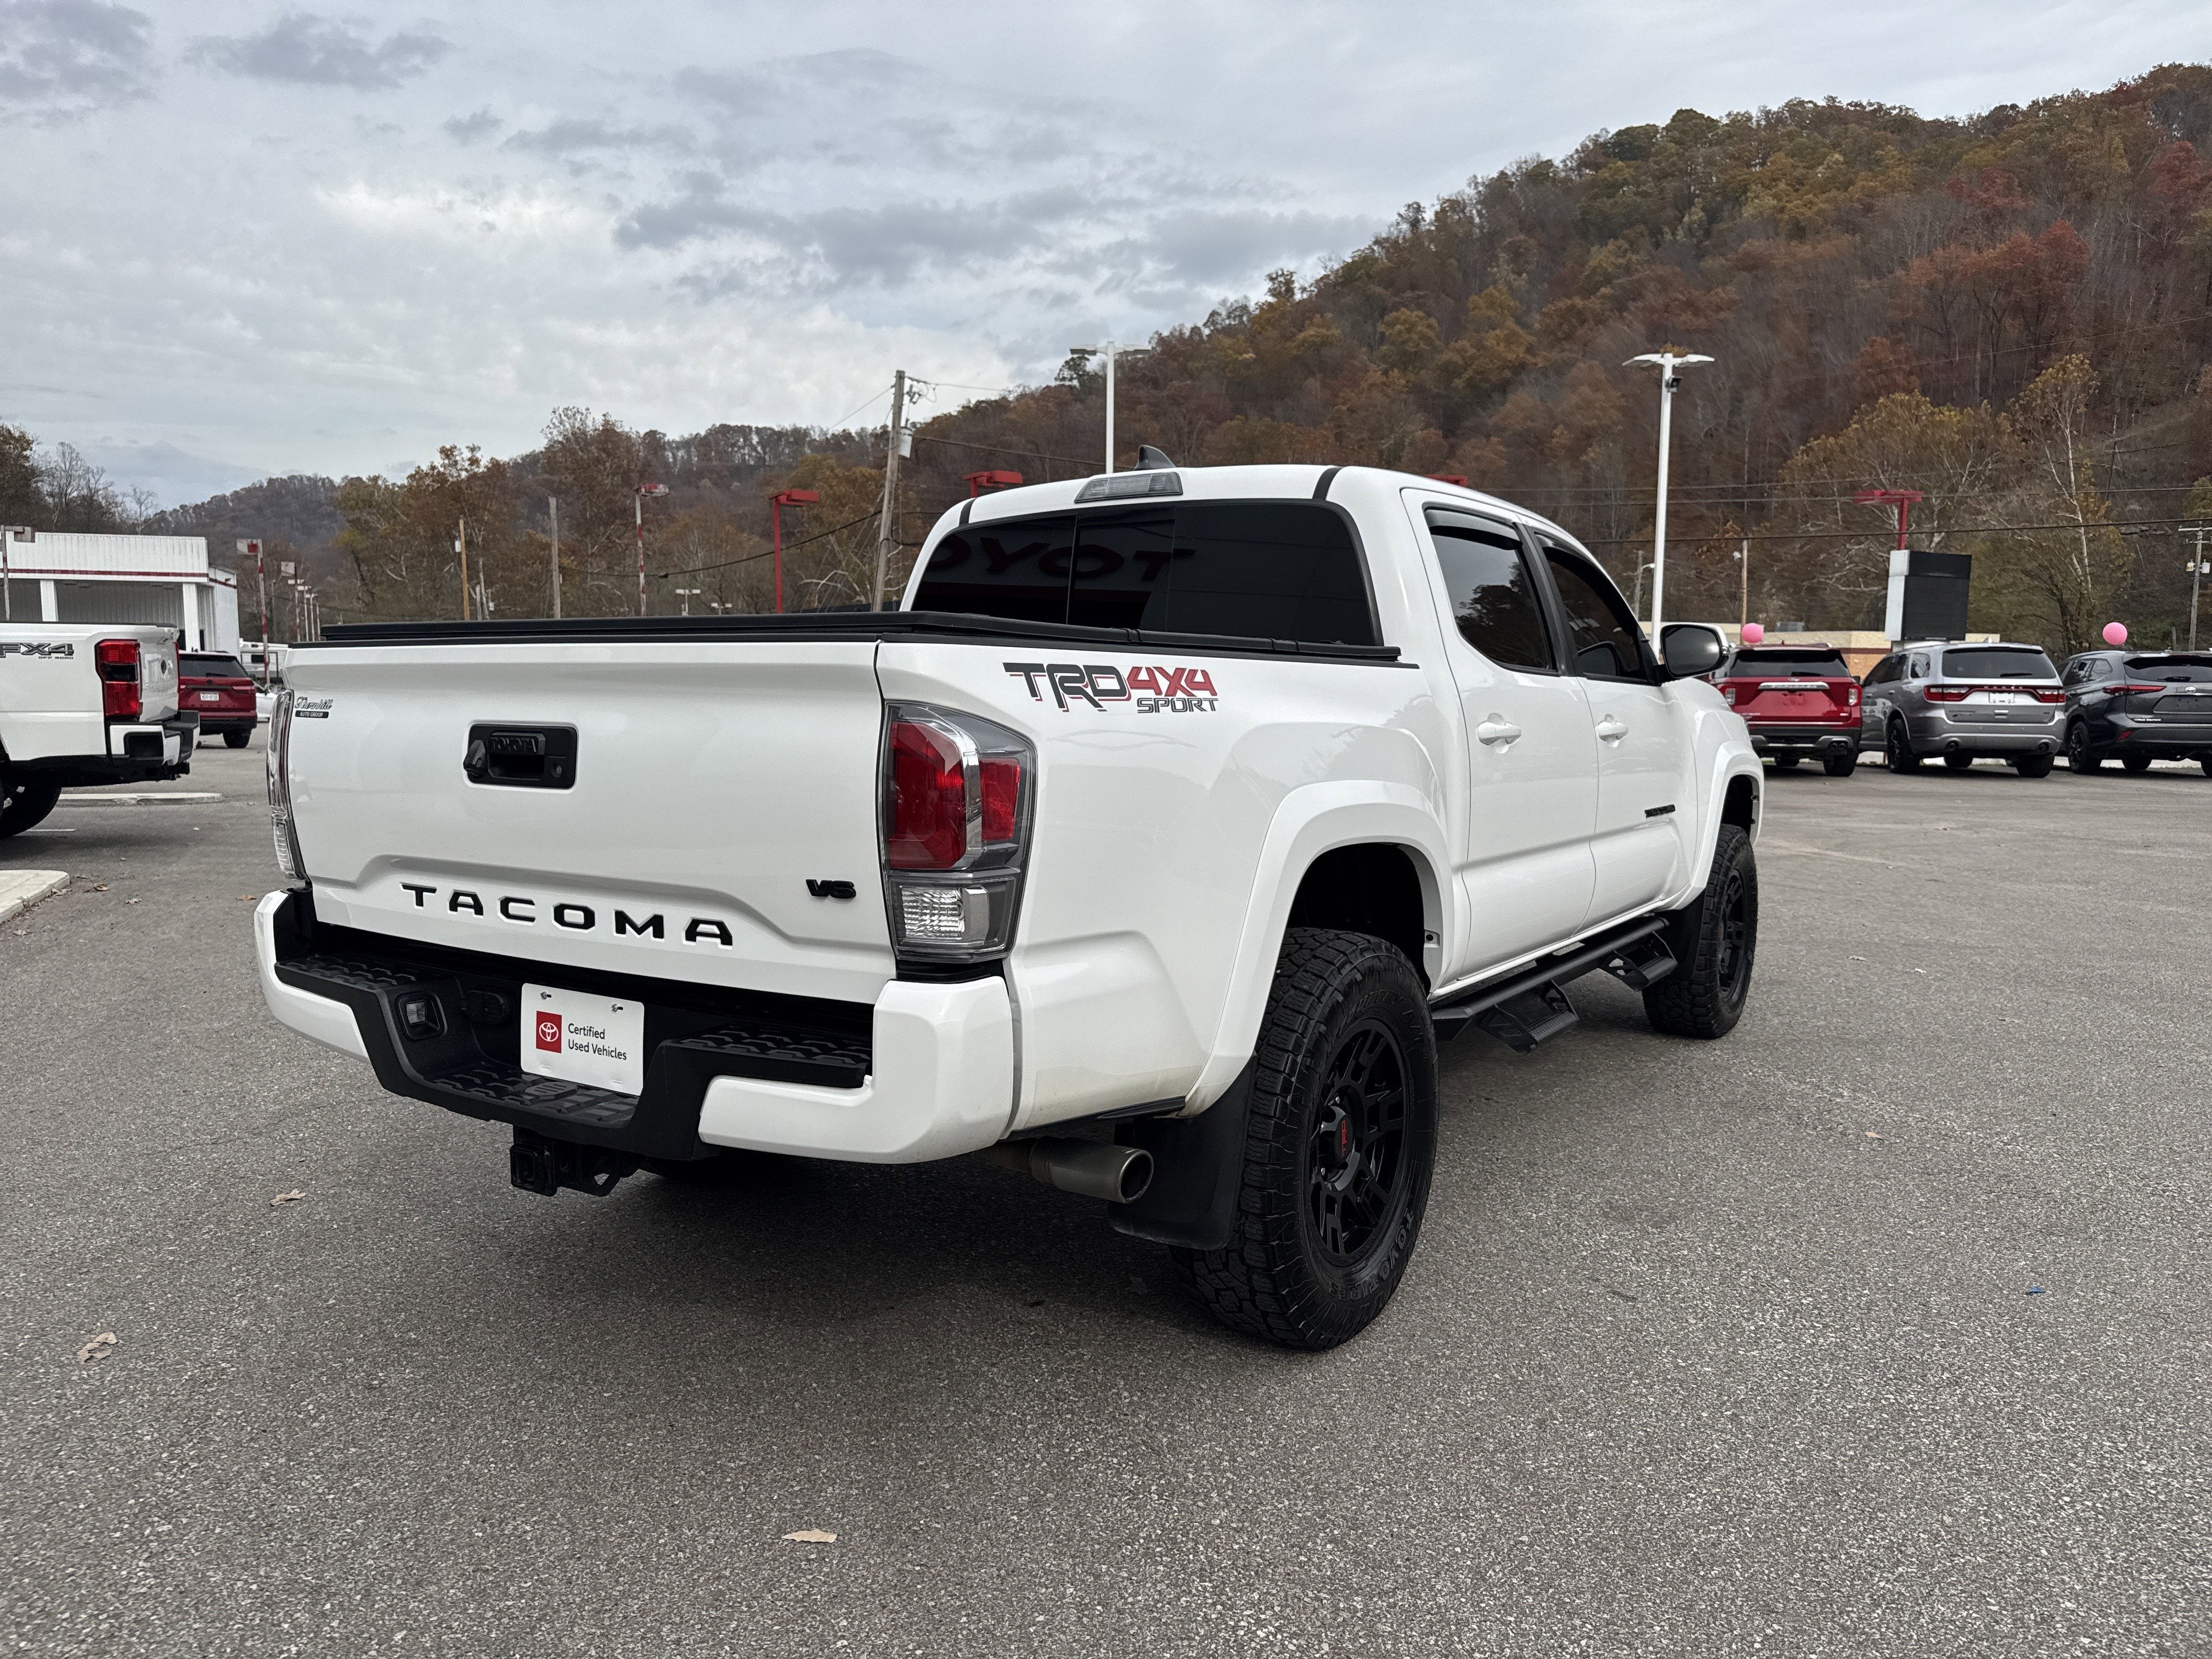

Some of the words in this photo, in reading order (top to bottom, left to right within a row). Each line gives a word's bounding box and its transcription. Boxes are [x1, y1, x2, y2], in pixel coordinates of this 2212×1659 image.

[0, 642, 74, 657] FX4
[1003, 662, 1131, 712] TRD
[295, 697, 334, 710] Thornhill
[1137, 697, 1218, 713] SPORT
[490, 737, 537, 752] TOYOTA
[805, 879, 856, 899] V6
[400, 883, 733, 948] TACOMA
[568, 1023, 605, 1040] Certified
[568, 1039, 590, 1053] Used
[591, 1043, 627, 1060] Vehicles
[1379, 1207, 1414, 1281] TOYO
